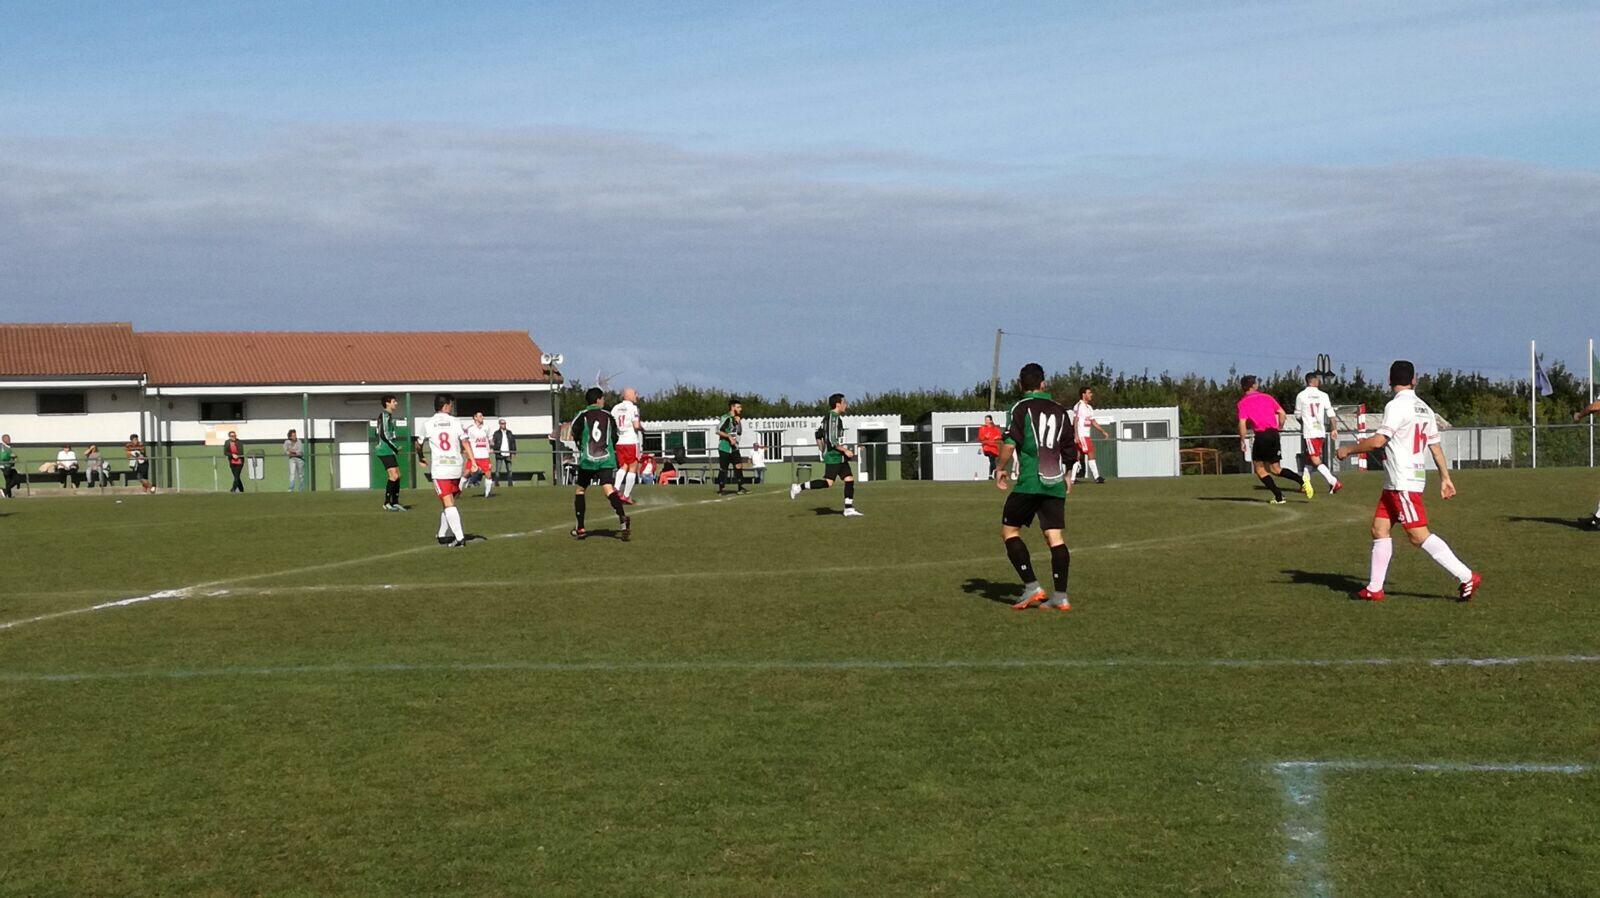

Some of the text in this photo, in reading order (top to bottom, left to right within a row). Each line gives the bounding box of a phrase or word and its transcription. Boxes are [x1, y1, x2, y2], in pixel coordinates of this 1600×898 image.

[591, 420, 602, 442] 6
[762, 420, 808, 429] ESTUDIANTES
[1038, 411, 1056, 449] 11
[438, 431, 451, 451] 8
